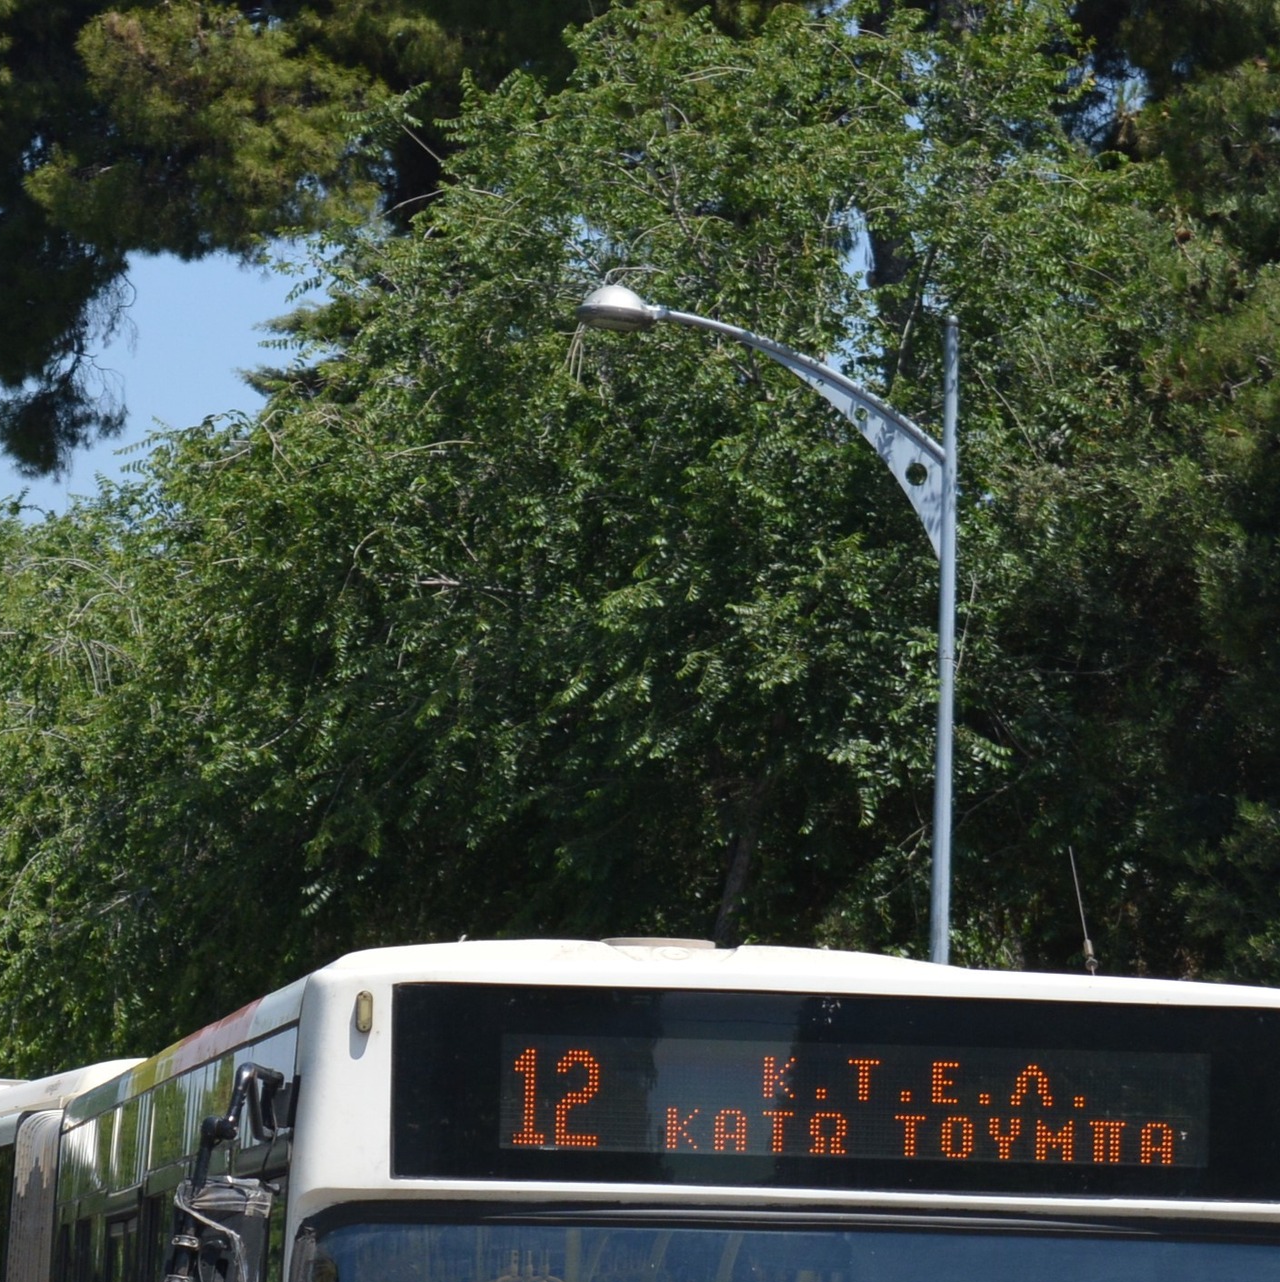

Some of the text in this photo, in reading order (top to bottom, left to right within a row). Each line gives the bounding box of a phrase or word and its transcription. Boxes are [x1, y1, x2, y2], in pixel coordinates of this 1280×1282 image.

[512, 1048, 600, 1147] 12
[762, 1055, 1085, 1108] Κ.Τ.Ε.Λ.
[665, 1106, 1173, 1165] ΚΑΤΩ ΤΟΥΜΠΑ
